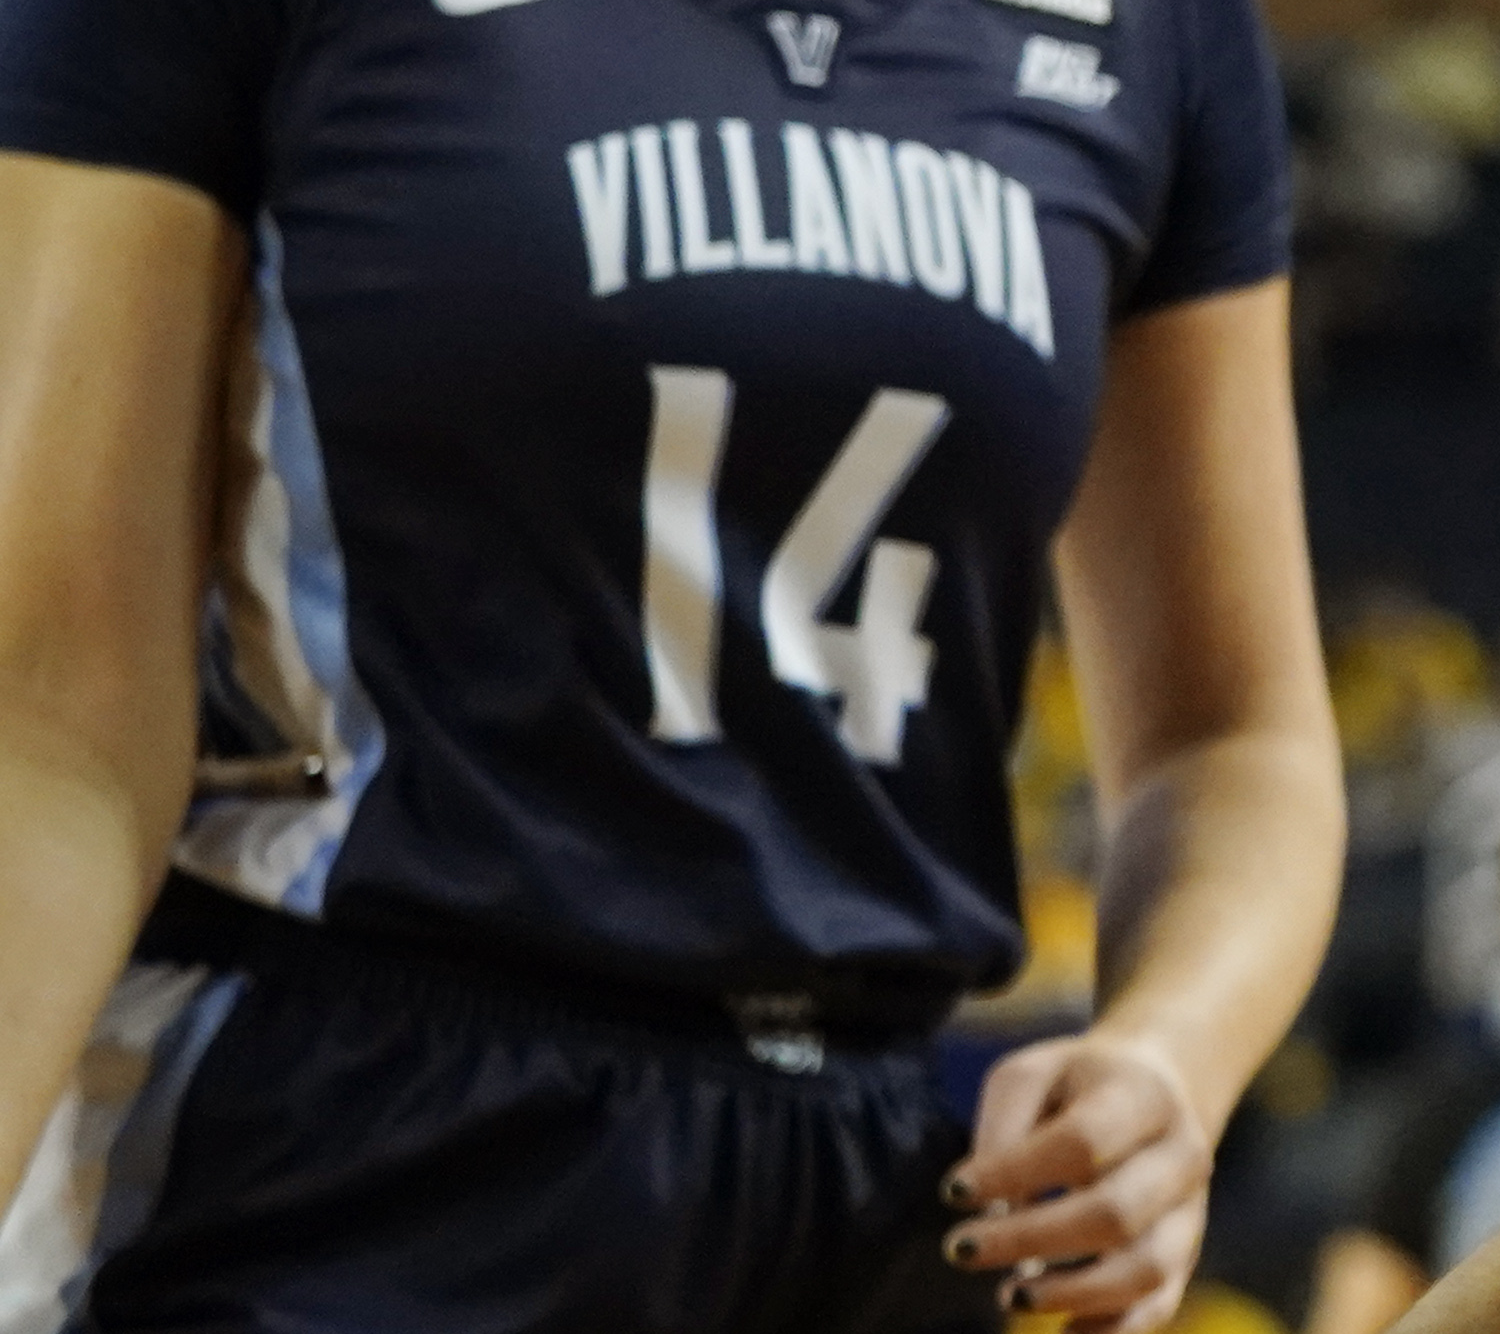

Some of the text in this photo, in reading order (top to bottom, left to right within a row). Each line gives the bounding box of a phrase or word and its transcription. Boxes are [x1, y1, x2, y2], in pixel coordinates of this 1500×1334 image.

[764, 9, 841, 88] V
[566, 117, 1055, 361] VILLANOVA
[642, 364, 952, 767] 14
